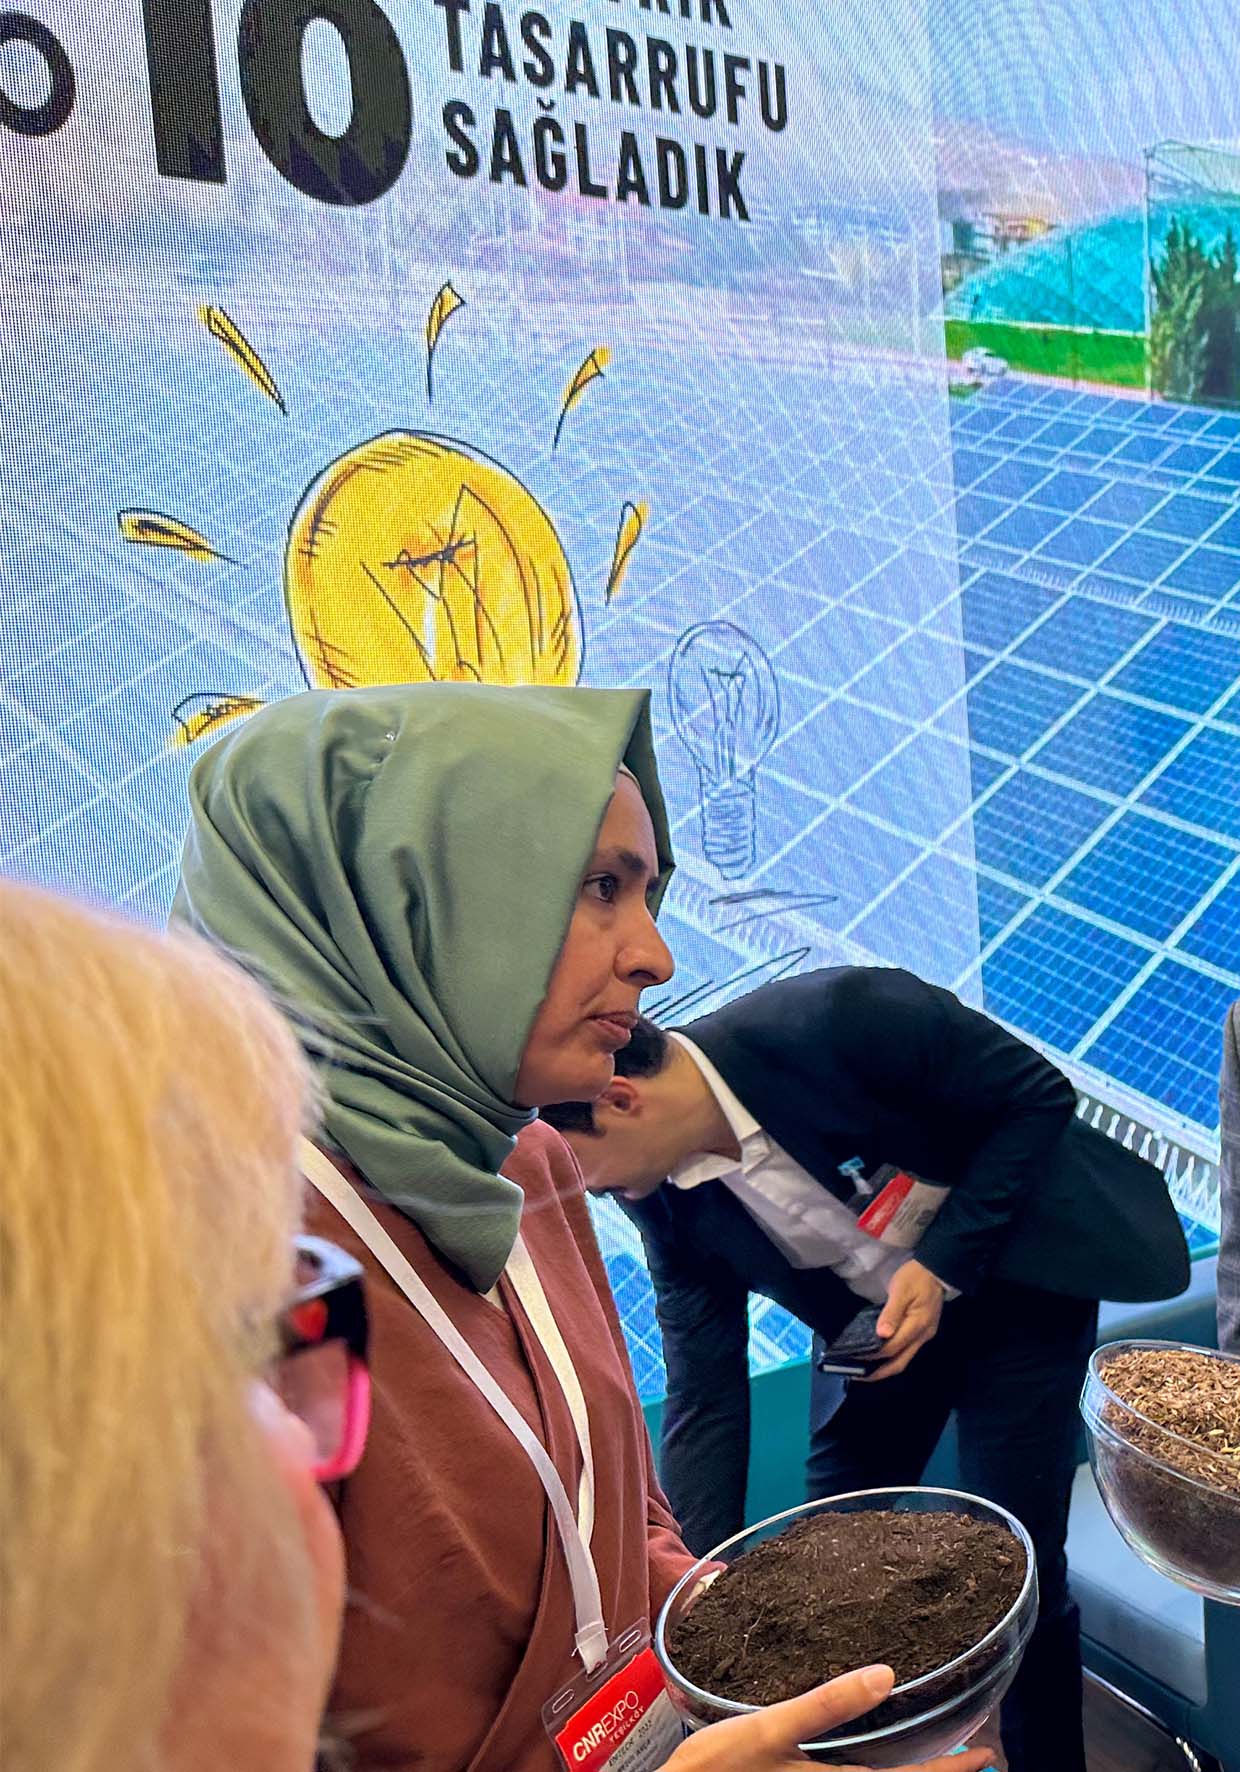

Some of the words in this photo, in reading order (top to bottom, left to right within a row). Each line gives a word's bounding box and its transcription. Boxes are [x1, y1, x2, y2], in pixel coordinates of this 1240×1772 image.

[434, 0, 787, 132] TASARRUFU
[442, 97, 751, 222] SAĞLADIK
[572, 1690, 639, 1761] CNREXPO
